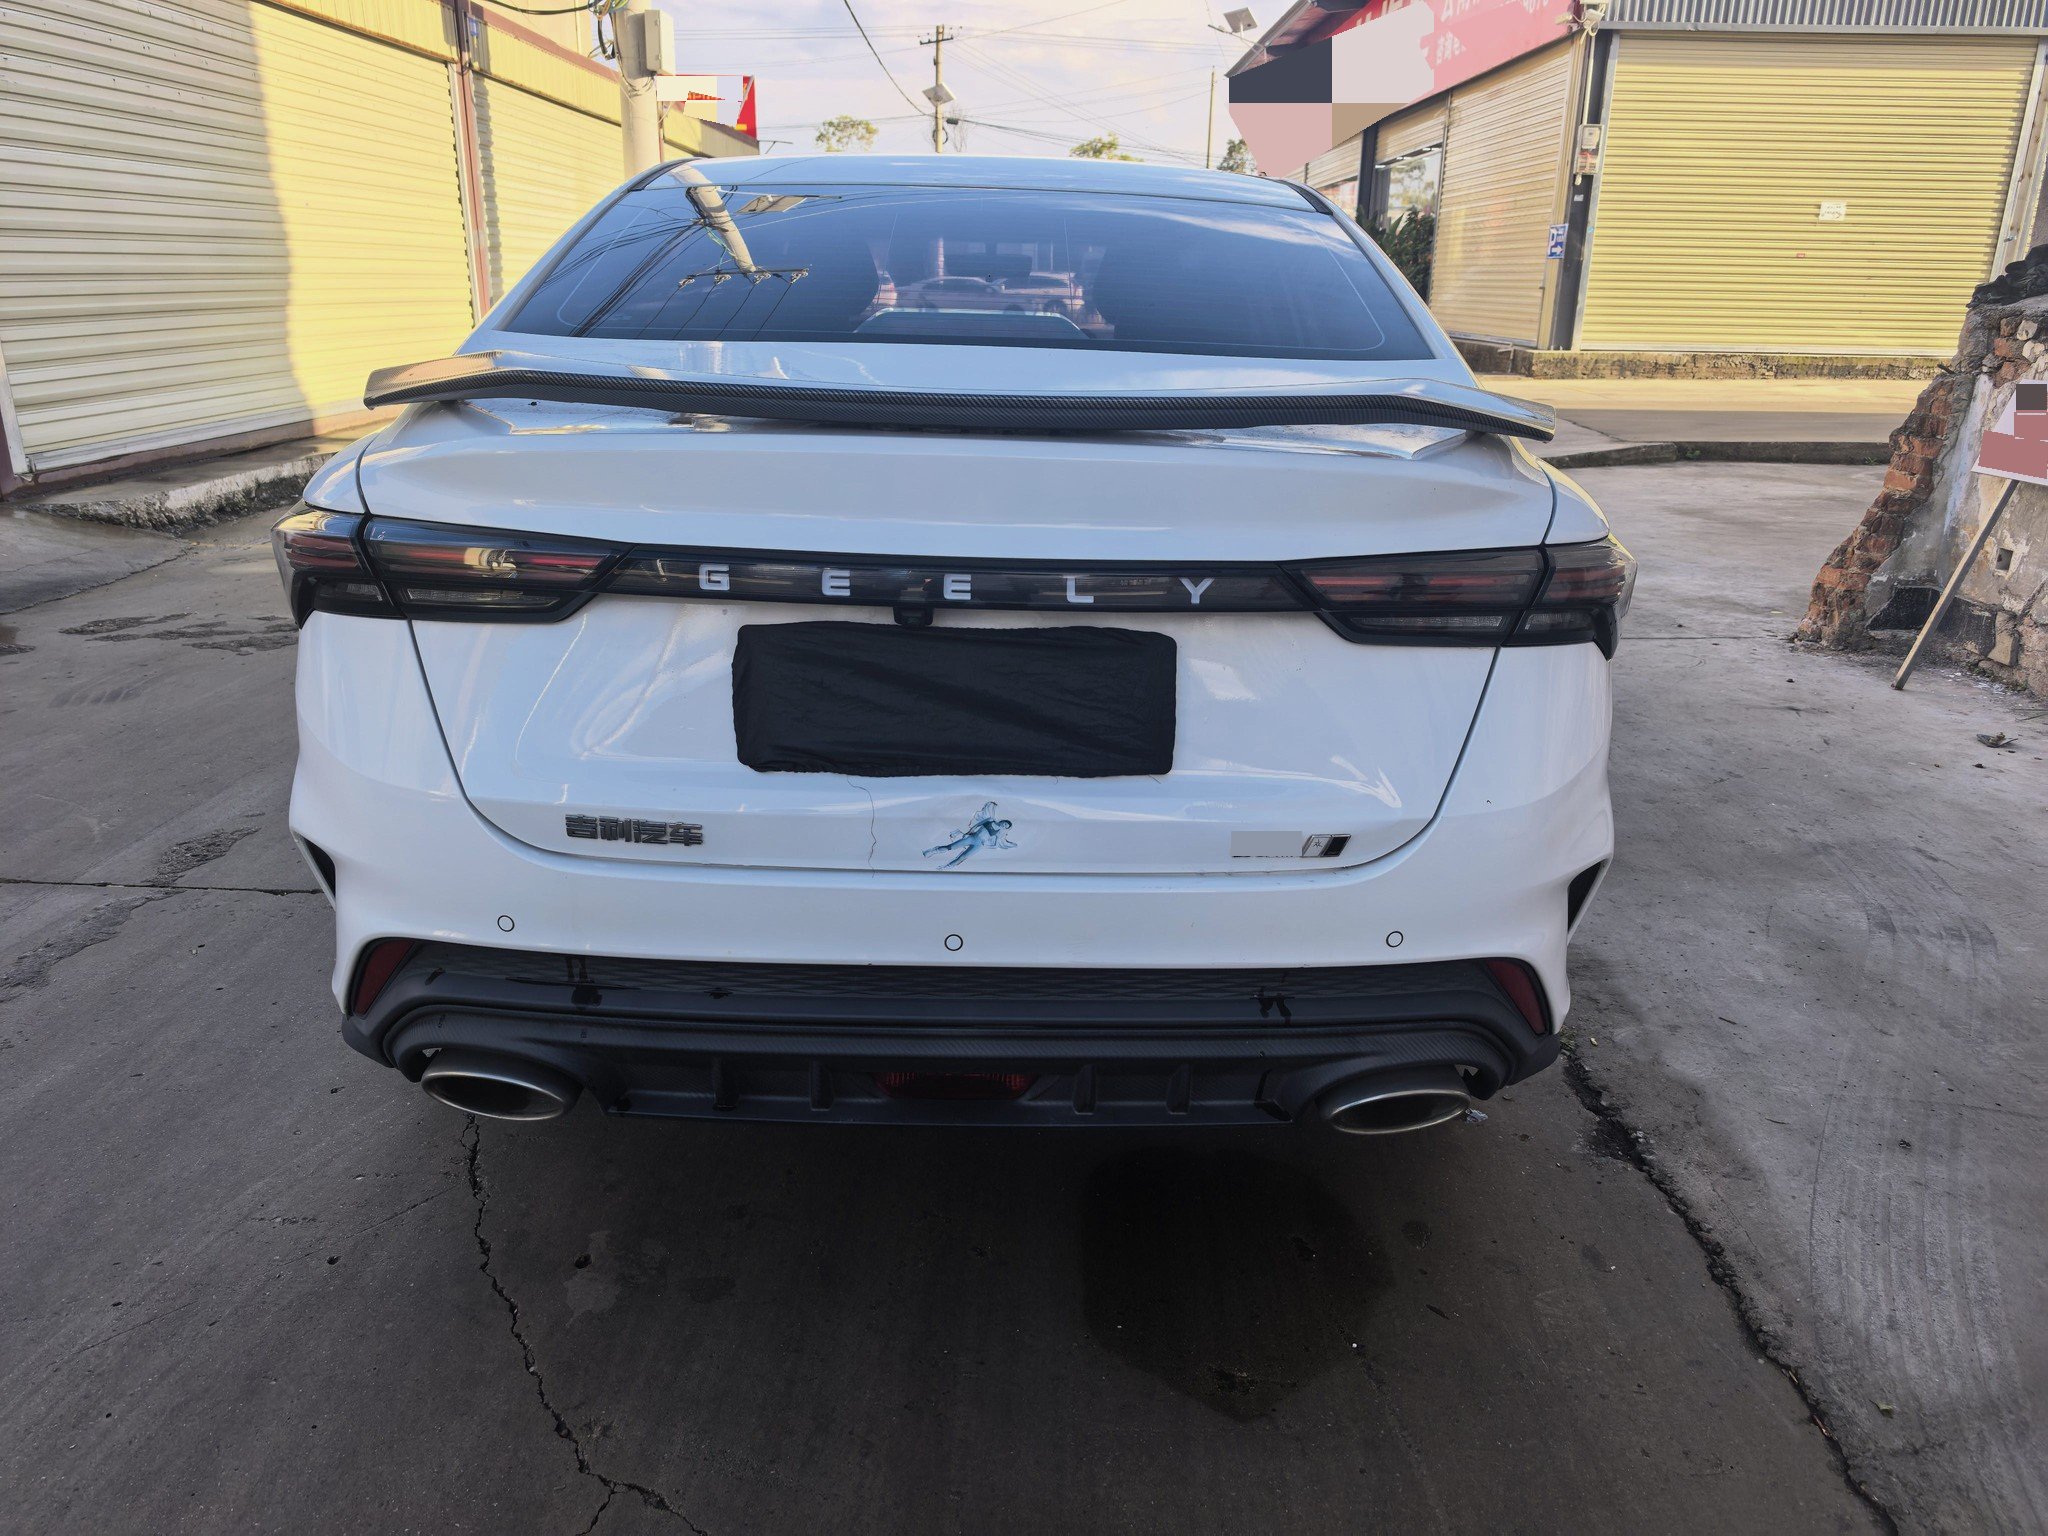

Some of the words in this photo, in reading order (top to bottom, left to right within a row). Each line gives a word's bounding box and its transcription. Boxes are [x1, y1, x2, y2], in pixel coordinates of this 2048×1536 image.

[699, 564, 1214, 604] GEELY
[565, 814, 703, 846] 吉利汽车
